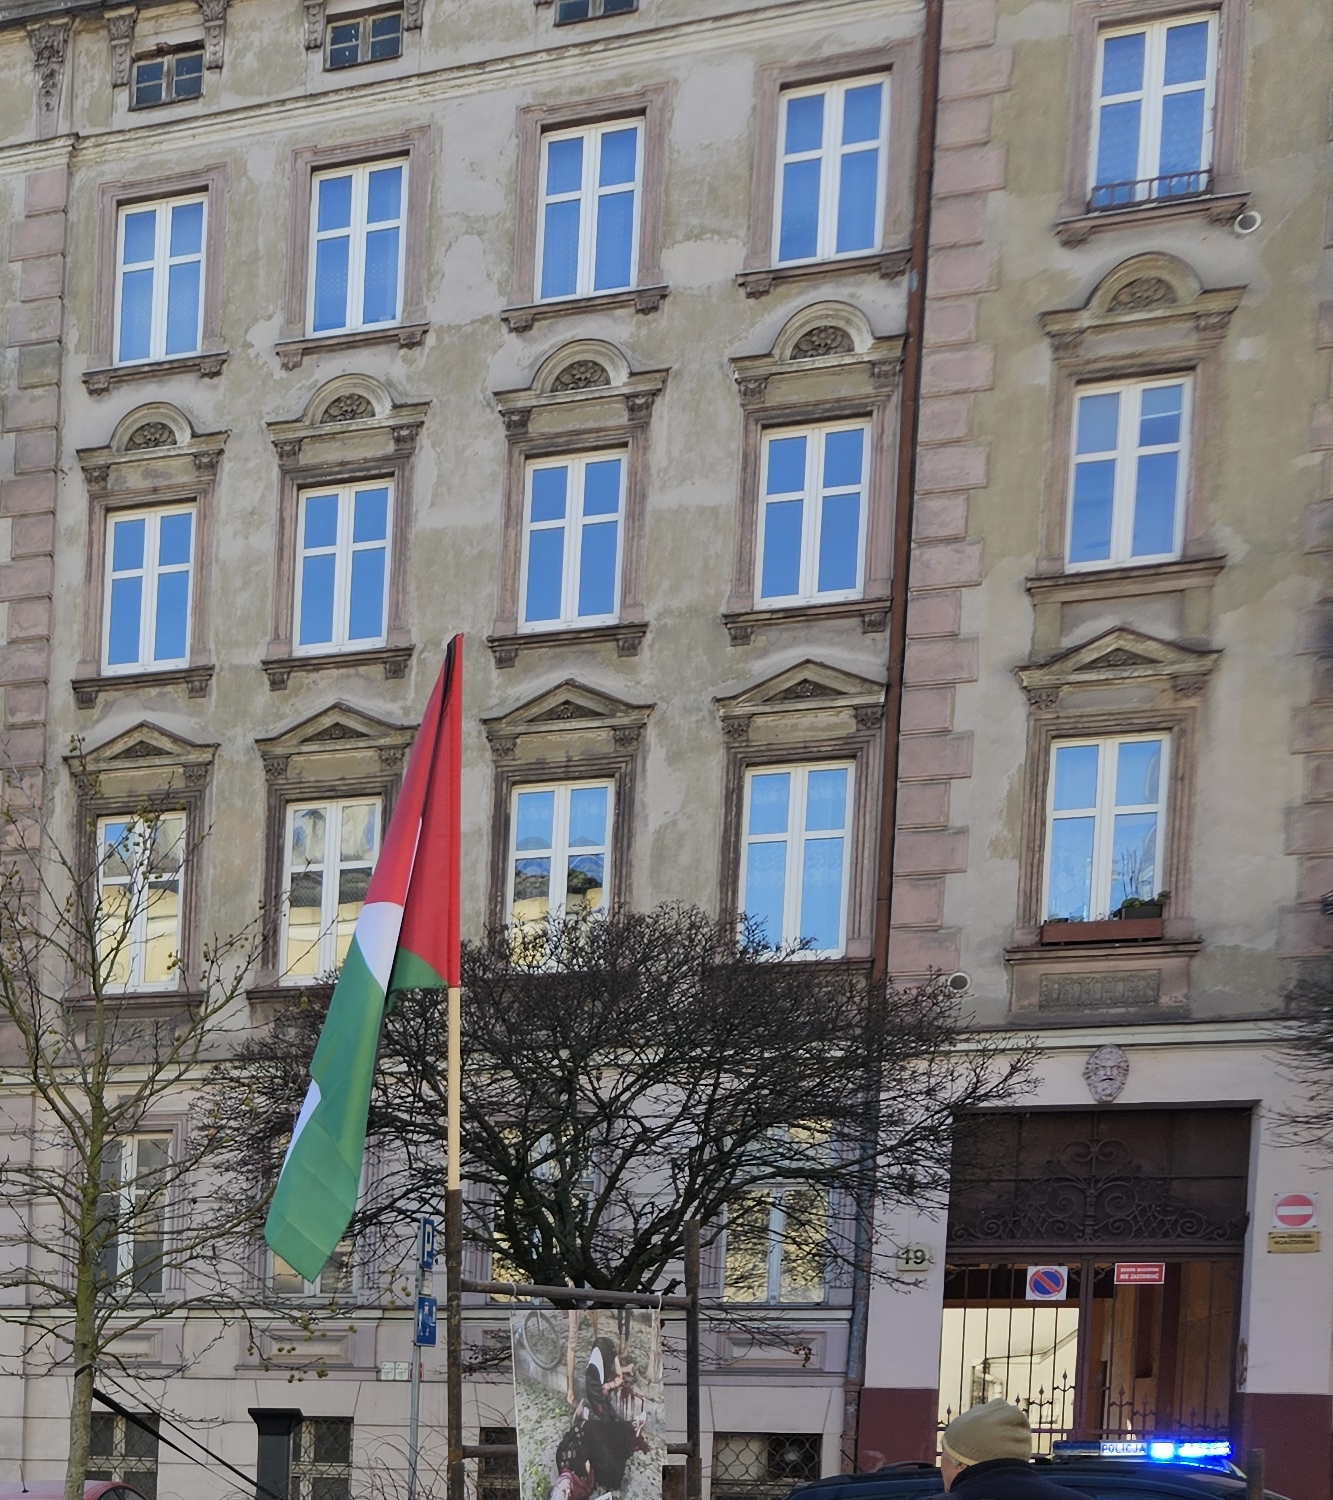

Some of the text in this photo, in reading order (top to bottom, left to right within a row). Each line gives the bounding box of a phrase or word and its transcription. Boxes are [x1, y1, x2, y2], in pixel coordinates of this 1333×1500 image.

[424, 1224, 433, 1261] P
[902, 1248, 926, 1265] 19
[1101, 1443, 1147, 1454] POLICJA
